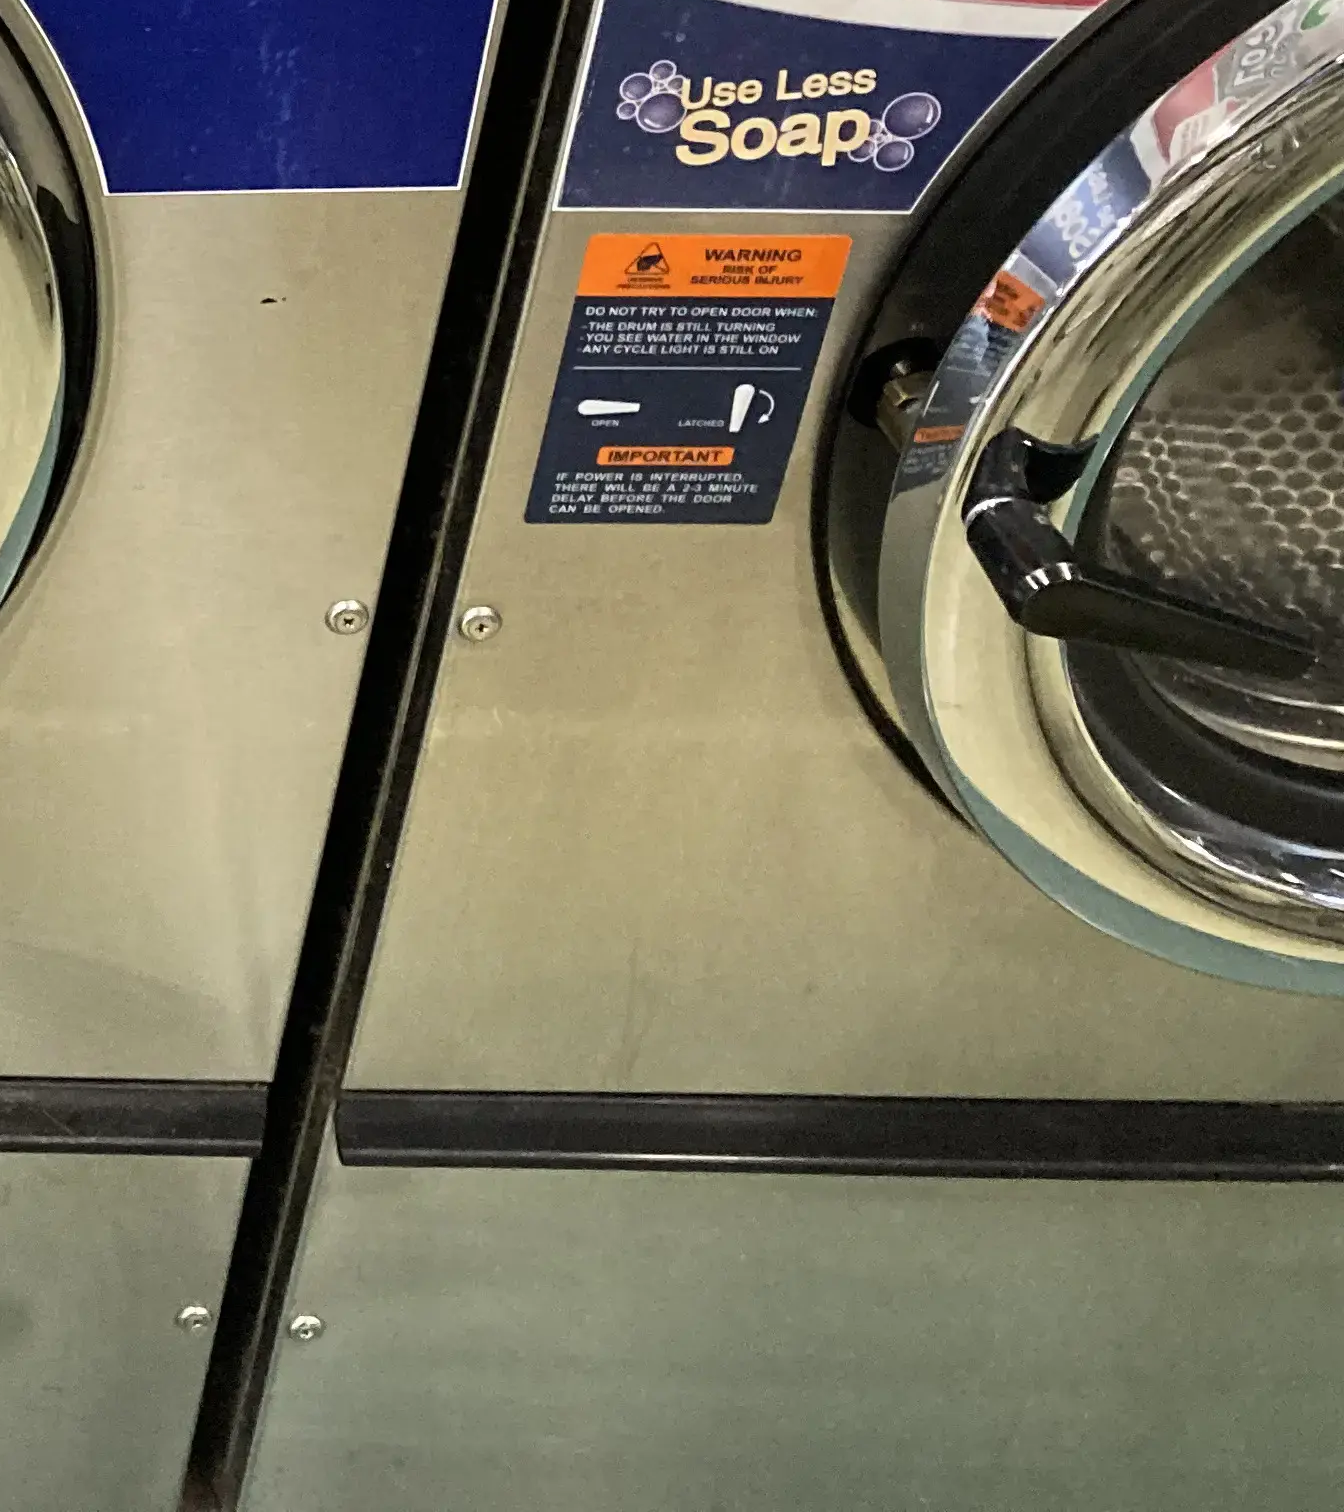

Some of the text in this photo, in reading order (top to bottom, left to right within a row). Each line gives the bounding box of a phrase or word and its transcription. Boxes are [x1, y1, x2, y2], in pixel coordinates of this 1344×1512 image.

[680, 69, 876, 110] Use Less
[675, 108, 871, 166] Soap
[704, 249, 802, 262] WARNING
[607, 449, 722, 462] IMPORTANT
